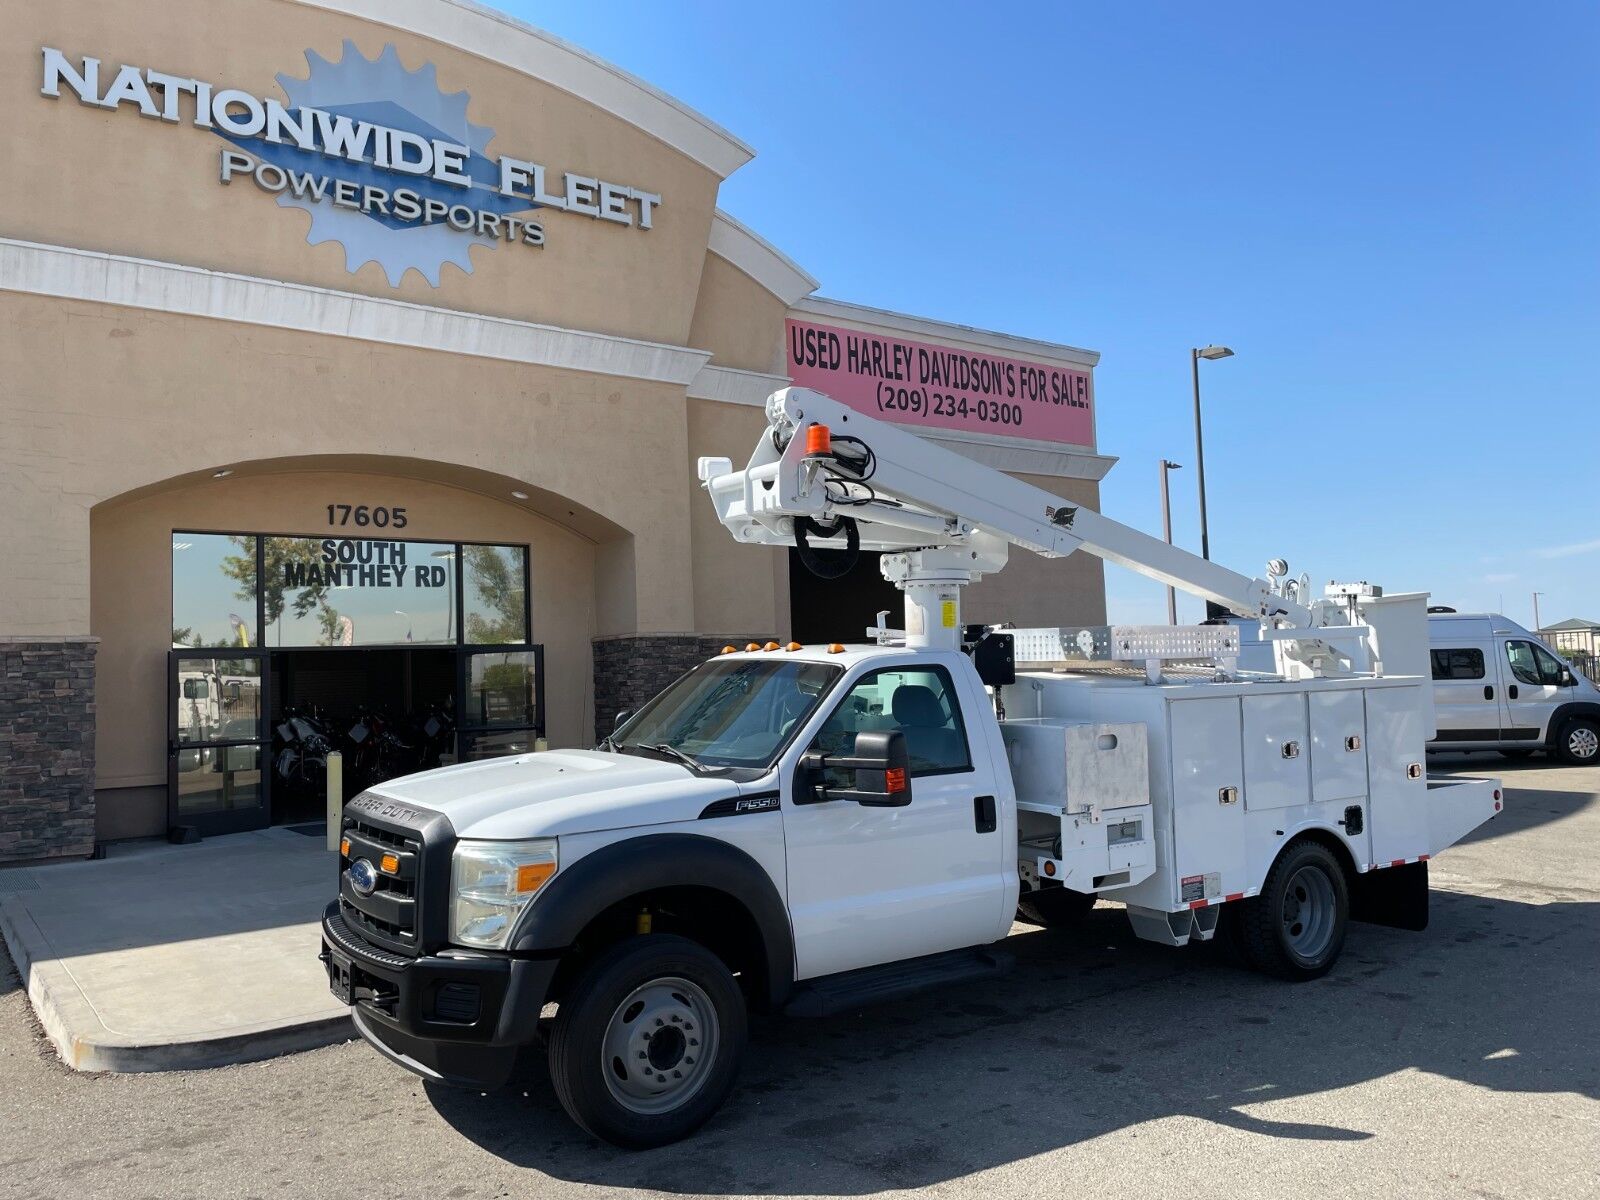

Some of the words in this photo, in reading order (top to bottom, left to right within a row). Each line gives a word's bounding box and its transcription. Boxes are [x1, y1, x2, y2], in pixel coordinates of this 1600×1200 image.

[42, 46, 471, 188] NATIONWIDE
[498, 155, 662, 230] FLEET
[792, 326, 841, 371] USED
[848, 336, 913, 381] HARLEY
[919, 348, 1015, 397] DAVIDSON'S
[1020, 367, 1048, 403] FOR
[1052, 372, 1089, 409] SALE!
[877, 382, 929, 417] (209)
[933, 394, 1022, 426] 234-0300
[327, 505, 408, 528] 17605
[322, 540, 405, 564] SOUTH
[285, 563, 407, 586] MANTHEY
[415, 566, 446, 587] RD
[354, 796, 381, 812] SUPER
[382, 806, 421, 821] DUTY
